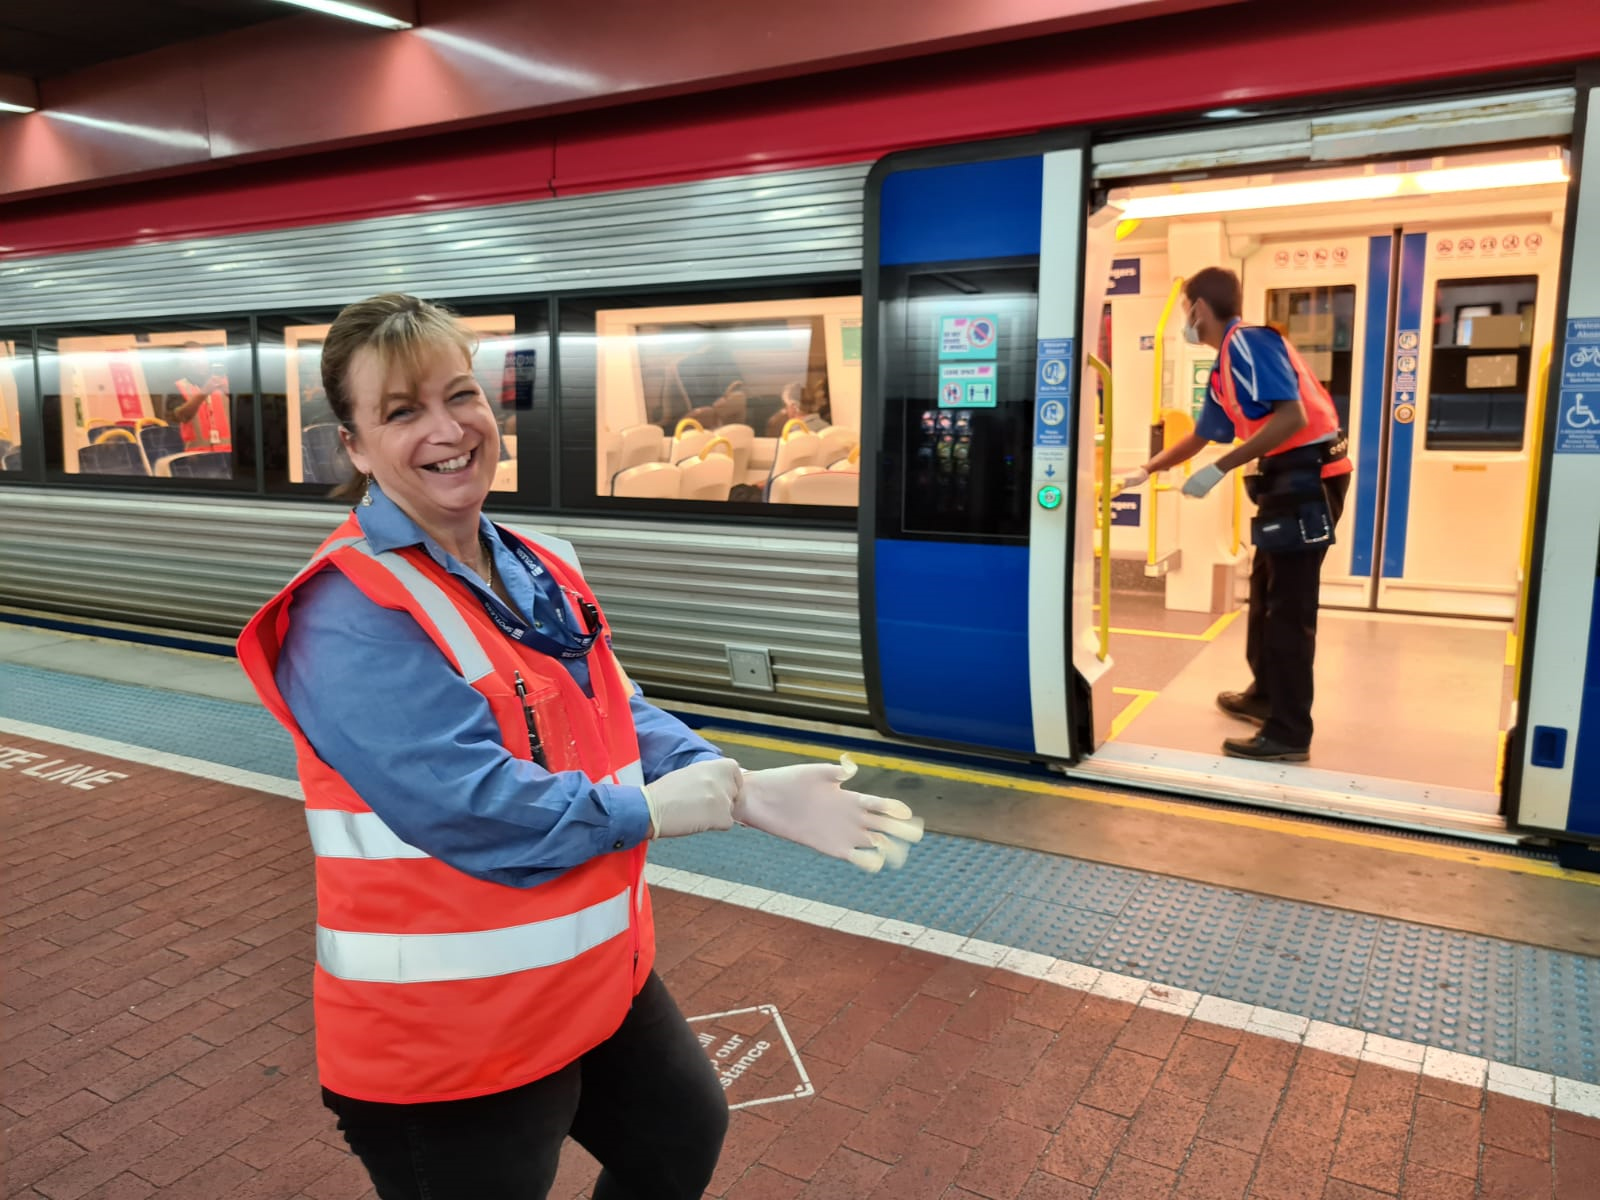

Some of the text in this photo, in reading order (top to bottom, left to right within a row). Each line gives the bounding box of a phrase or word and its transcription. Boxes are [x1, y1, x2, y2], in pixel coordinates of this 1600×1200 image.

[0, 744, 129, 791] TE LINE
[719, 1040, 771, 1091] stance
